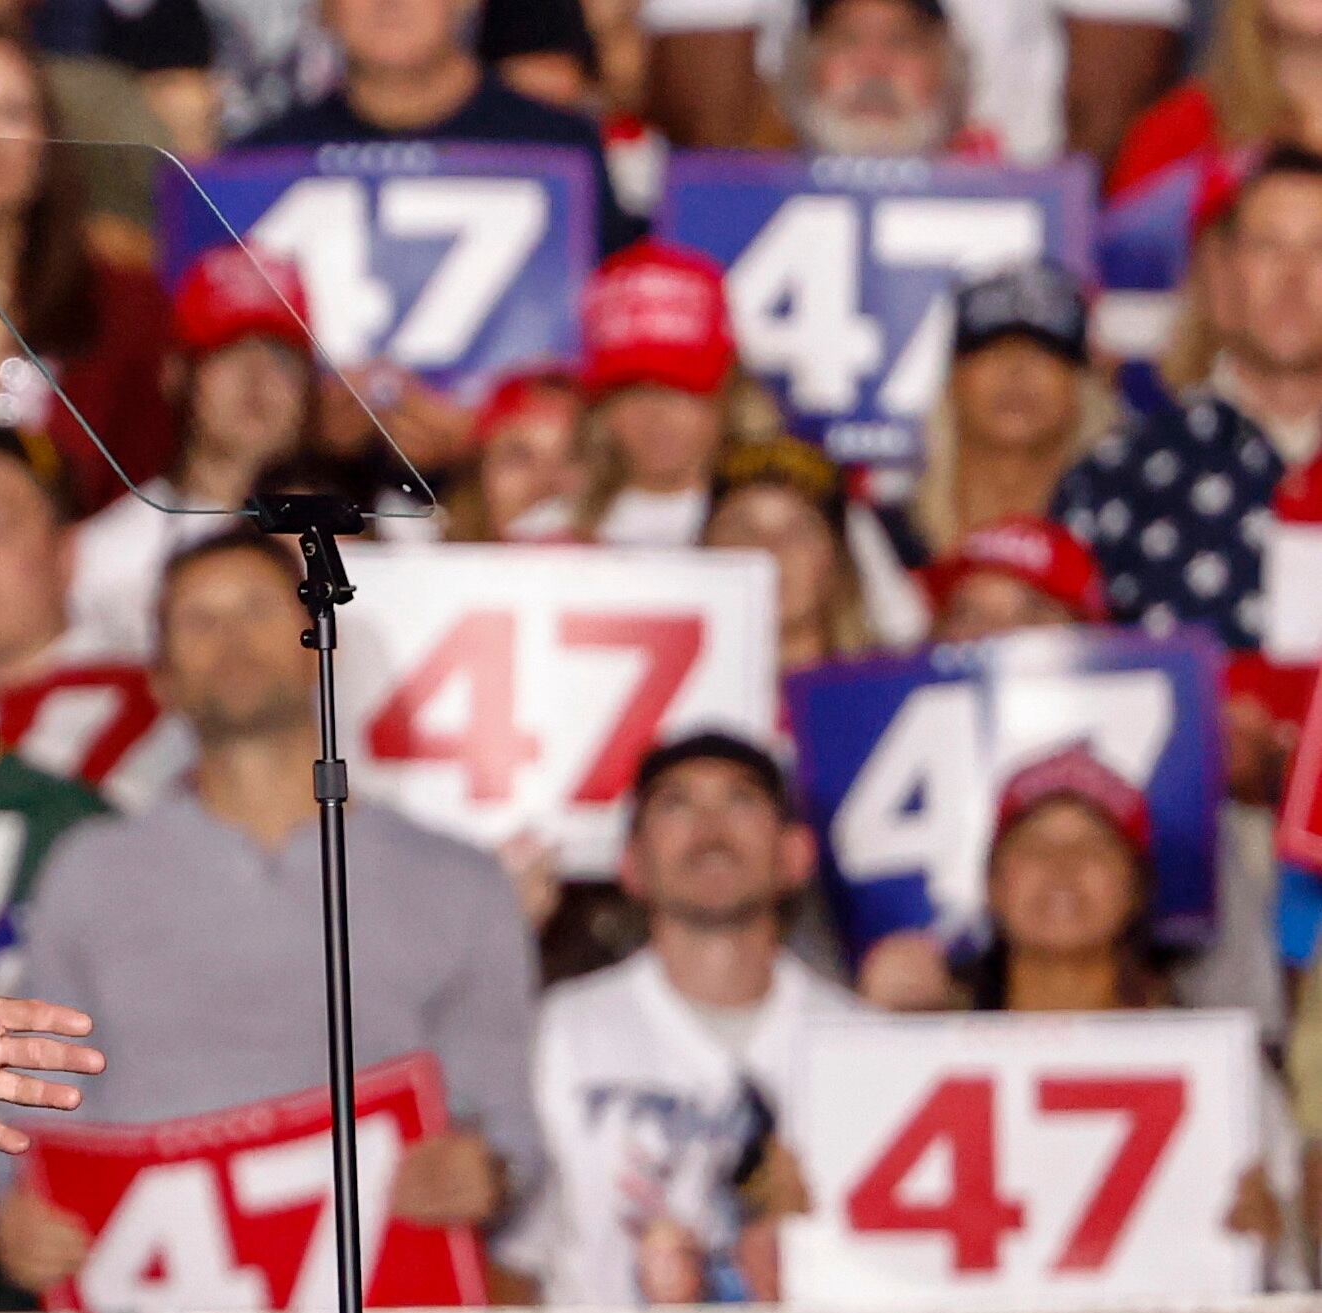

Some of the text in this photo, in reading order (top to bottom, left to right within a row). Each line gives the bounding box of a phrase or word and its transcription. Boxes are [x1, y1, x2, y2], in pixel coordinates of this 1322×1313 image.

[250, 175, 550, 370] 47
[722, 195, 1047, 418] 47
[363, 606, 709, 810] 47
[831, 664, 1175, 945] 47
[77, 1110, 407, 1312] 47
[844, 1070, 1190, 1275] 47
